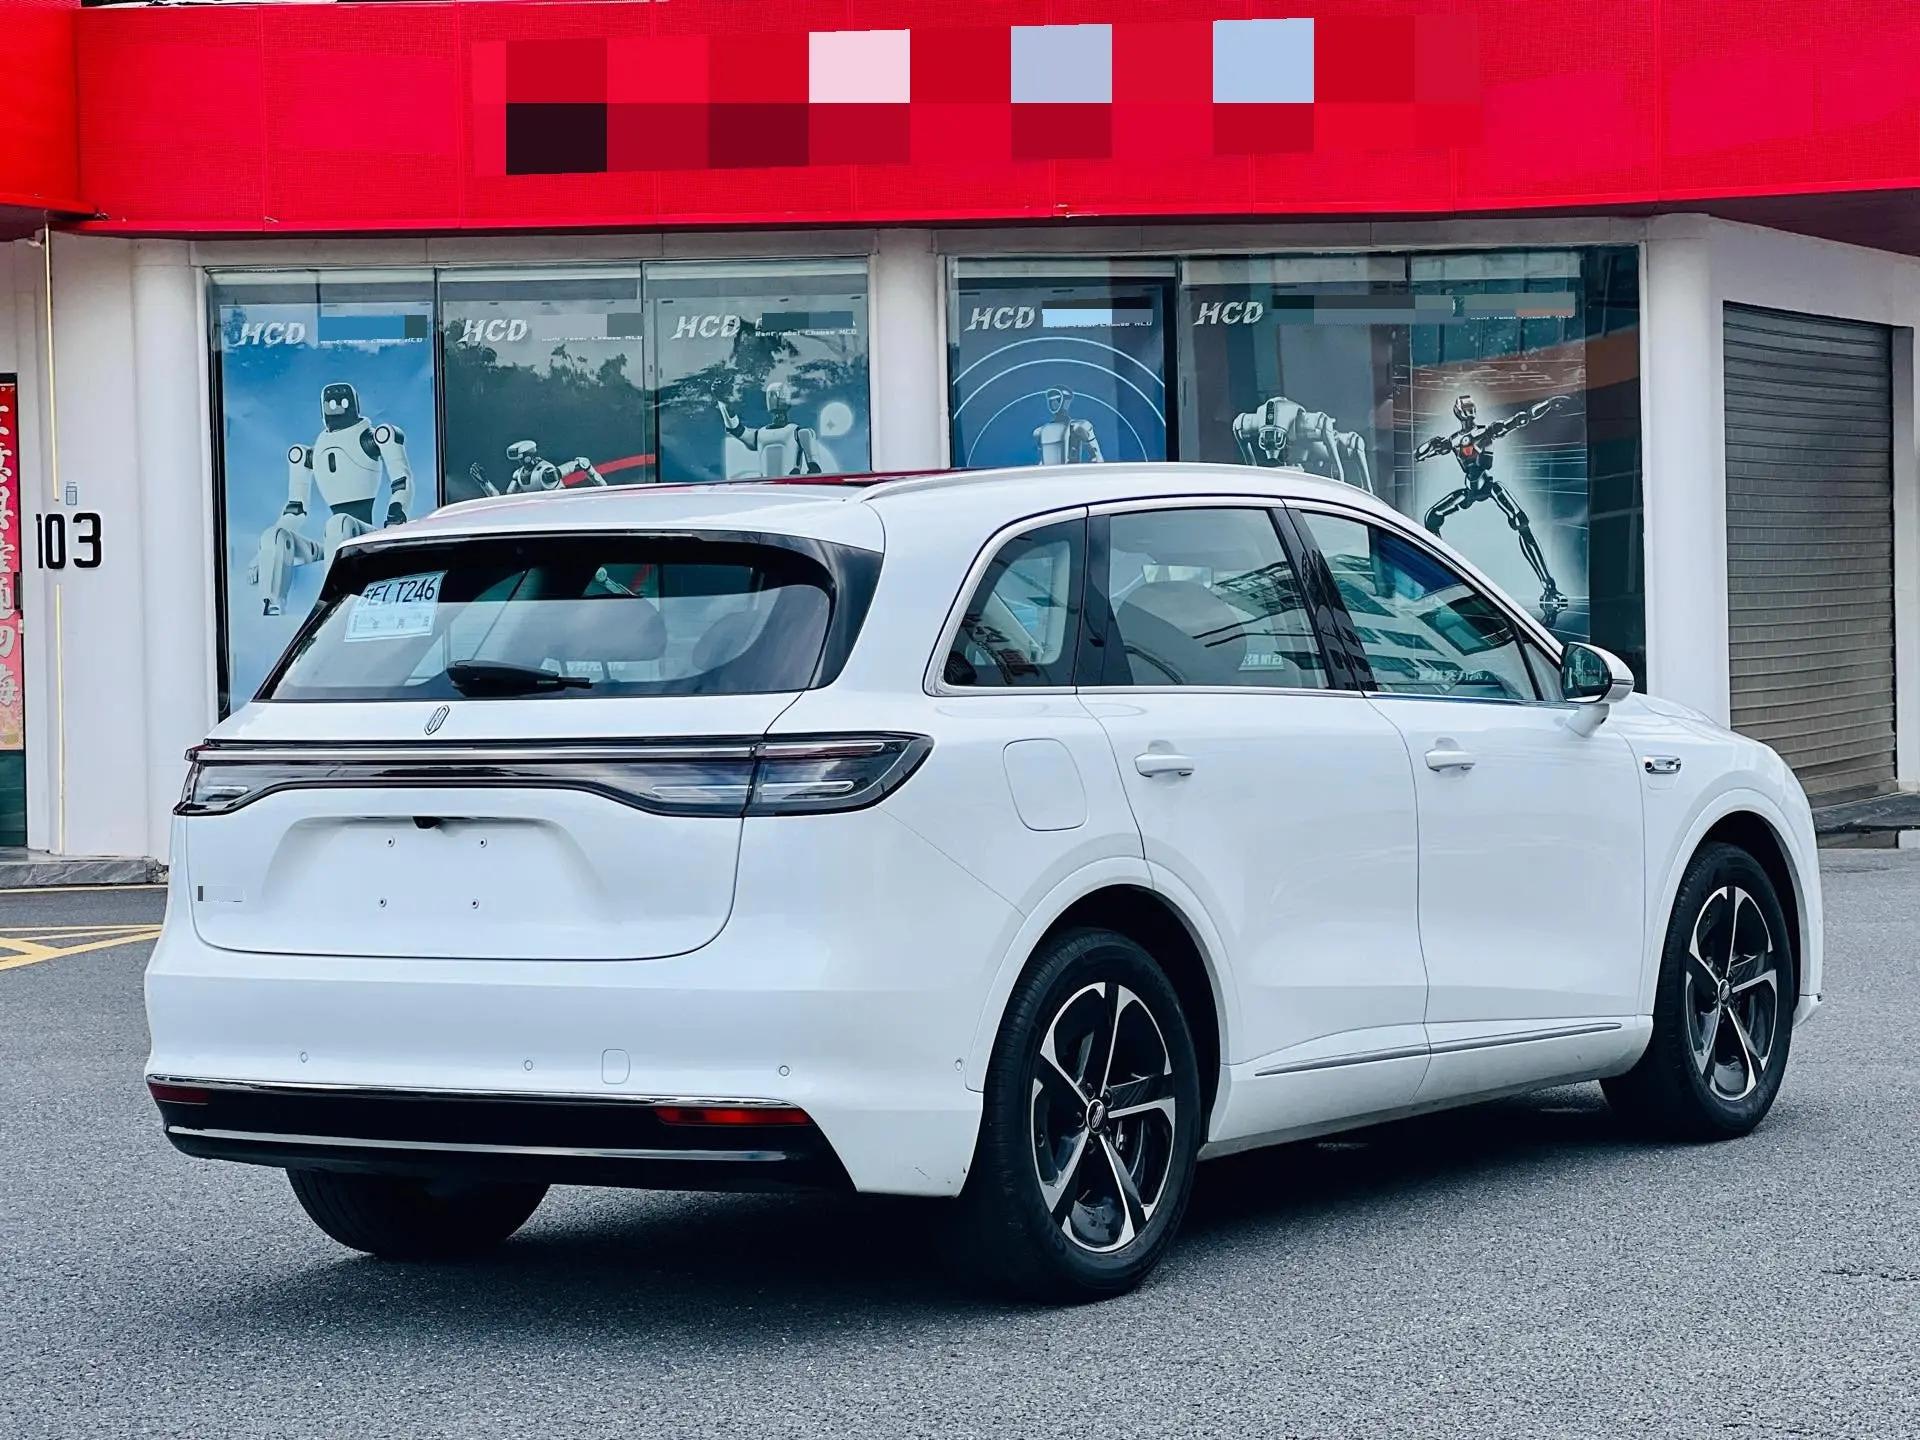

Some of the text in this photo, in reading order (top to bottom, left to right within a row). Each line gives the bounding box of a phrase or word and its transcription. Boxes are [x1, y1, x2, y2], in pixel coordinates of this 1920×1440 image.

[963, 306, 1036, 331] HCD
[1193, 302, 1264, 325] HCD
[233, 322, 306, 345] HCD
[456, 319, 528, 343] HCD
[670, 315, 741, 340] HCD
[36, 513, 102, 569] 103
